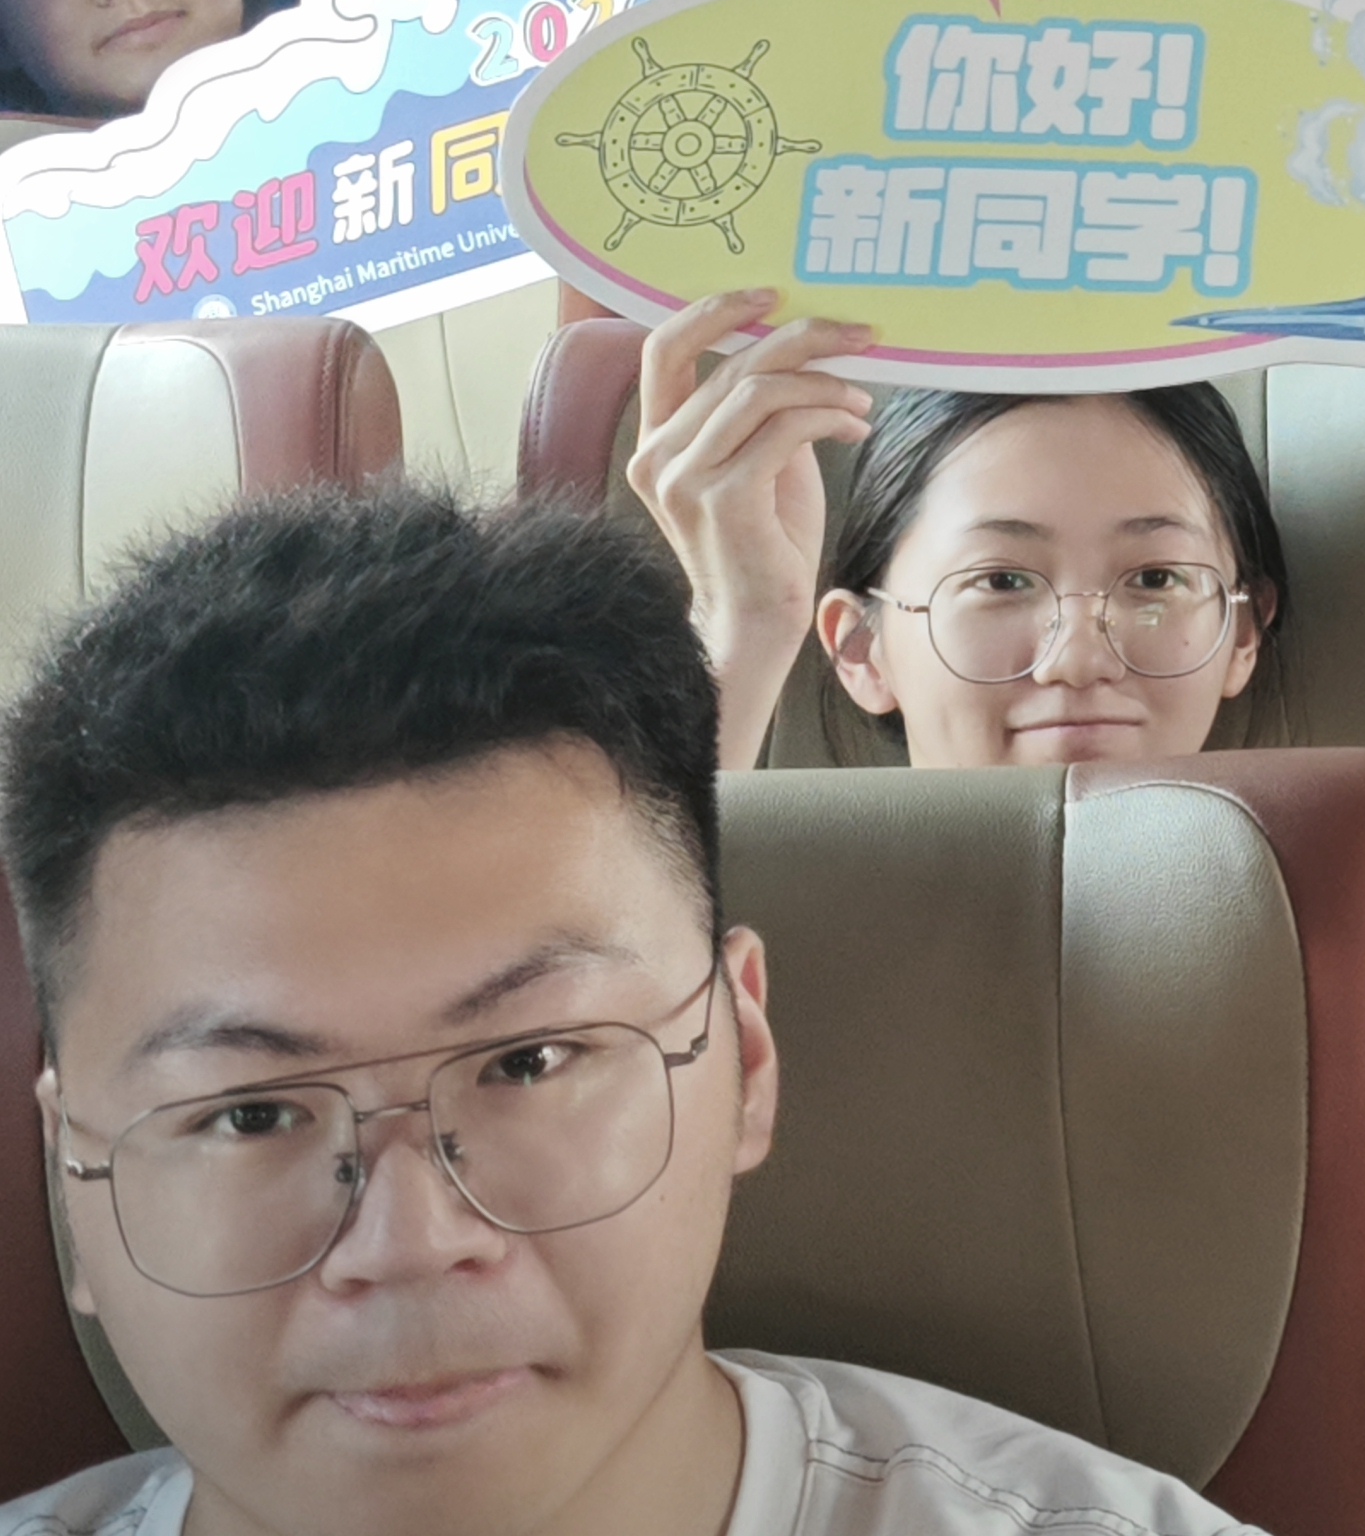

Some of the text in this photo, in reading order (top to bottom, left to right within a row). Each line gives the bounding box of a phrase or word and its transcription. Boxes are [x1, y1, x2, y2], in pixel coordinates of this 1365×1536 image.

[133, 113, 504, 304] 欢迎新同
[251, 267, 354, 316] Shanghai
[358, 240, 455, 285] Maritime
